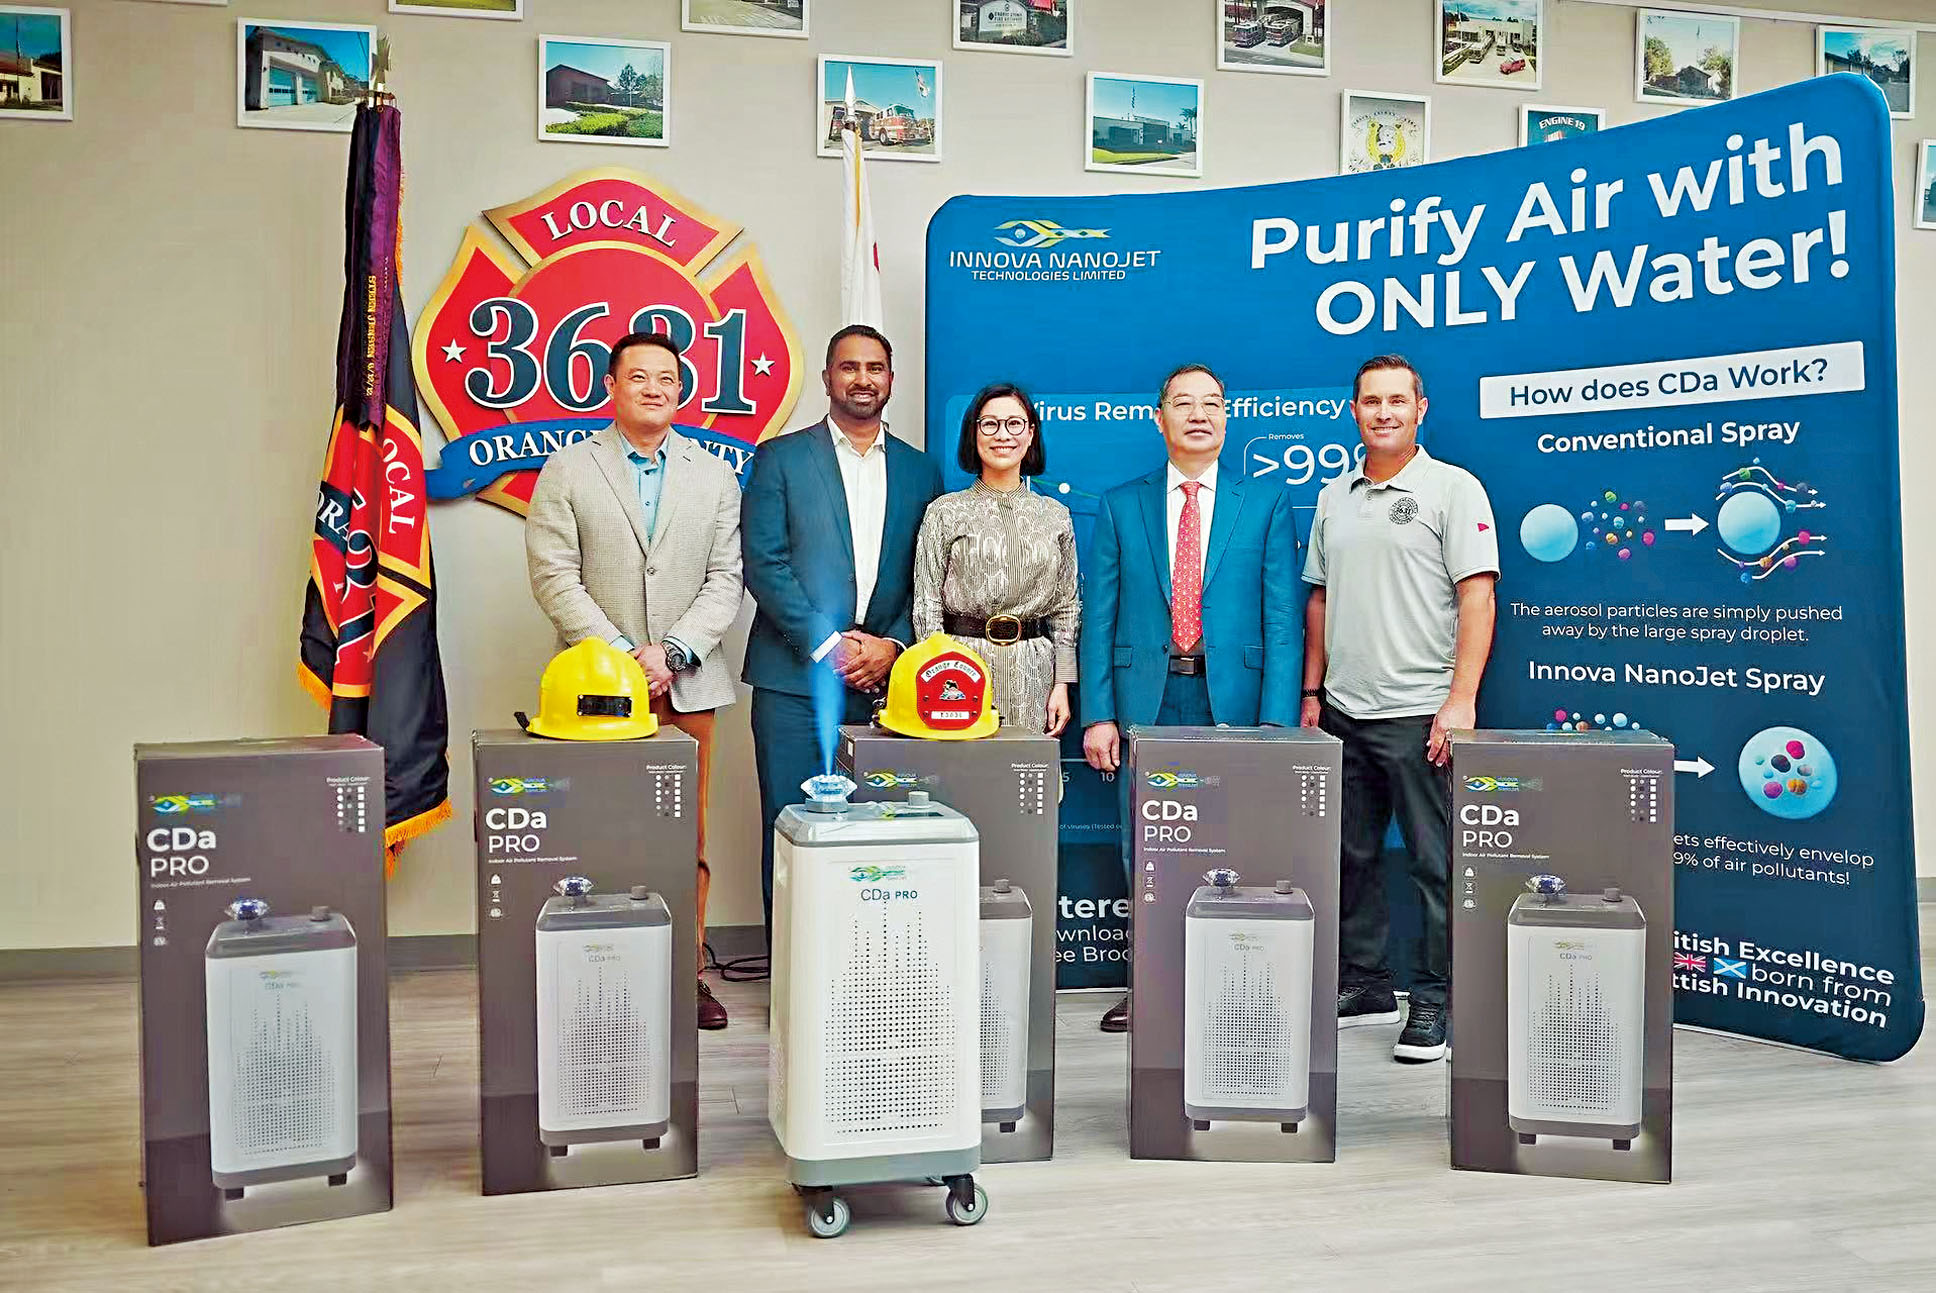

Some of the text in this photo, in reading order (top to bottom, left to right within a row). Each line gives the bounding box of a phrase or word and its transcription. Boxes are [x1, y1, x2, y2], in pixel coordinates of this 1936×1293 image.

[1539, 116, 1586, 131] ENGINE 19
[1251, 122, 1843, 269] Purify Air with
[540, 200, 677, 248] LOCAL
[950, 250, 1162, 269] INNOVA NANOJET
[971, 270, 1126, 281] TECHNOLOGIES LIMITED
[1315, 209, 1850, 335] ONLY Water!
[1510, 357, 1829, 407] How does CDa Work?
[1268, 433, 1305, 441] Removes
[1537, 420, 1801, 454] Conventional Spray
[1510, 603, 1843, 622] The aerosol particles are simply pushed
[1542, 624, 1810, 644] away by the large spray droplet.
[1529, 660, 1826, 696] Innova NanoJet Spray
[1101, 771, 1115, 782] 10
[486, 808, 547, 830] CDa
[1142, 800, 1198, 821] CDa
[1460, 804, 1520, 826] CDa
[147, 827, 217, 852] CDa
[488, 834, 541, 853] PRO
[1144, 825, 1192, 843] PRO
[1462, 831, 1513, 849] PRO
[1673, 834, 1874, 869] ets effectively envelop
[150, 855, 210, 878] PRO
[1673, 852, 1850, 885] 9% of air pollutants!
[861, 888, 918, 901] CDa PRO
[1673, 930, 1895, 985] itish Excellence
[1752, 963, 1892, 1007] born from
[1737, 981, 1888, 1028] Innovation
